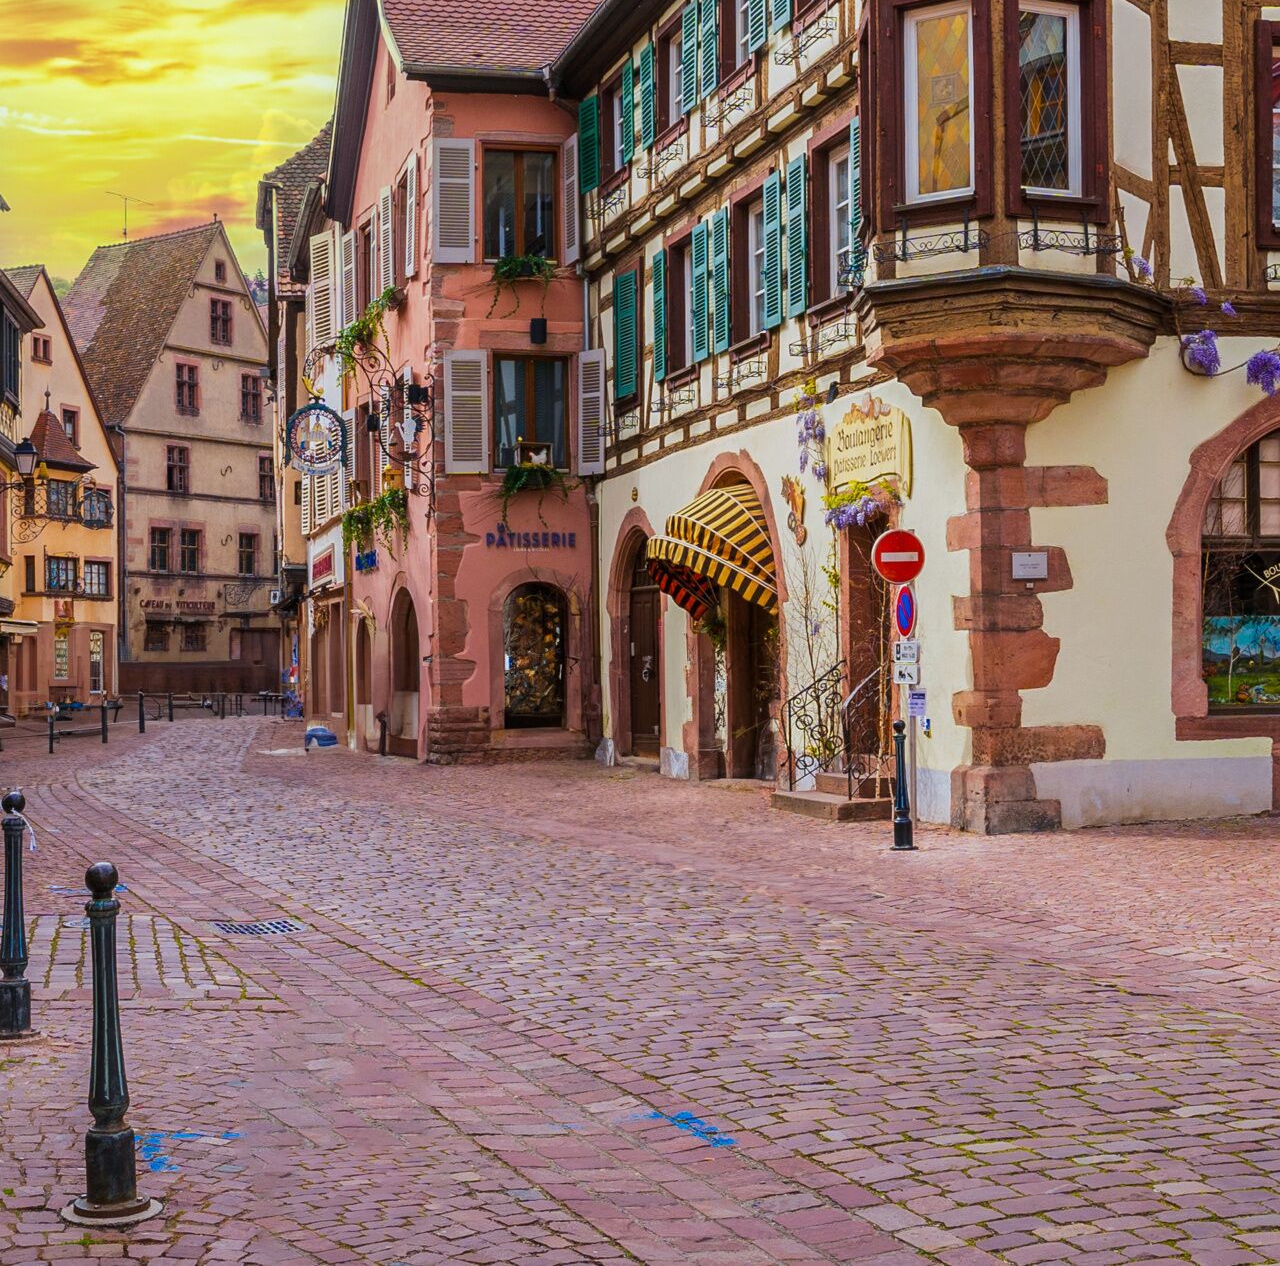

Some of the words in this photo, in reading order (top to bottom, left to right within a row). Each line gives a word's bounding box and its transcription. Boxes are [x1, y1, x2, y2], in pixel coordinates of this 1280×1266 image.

[837, 422, 893, 452] Boulangerie
[870, 445, 897, 466] Loewert
[140, 599, 164, 609] CAVEAU
[176, 600, 215, 610] VITICULTEUR
